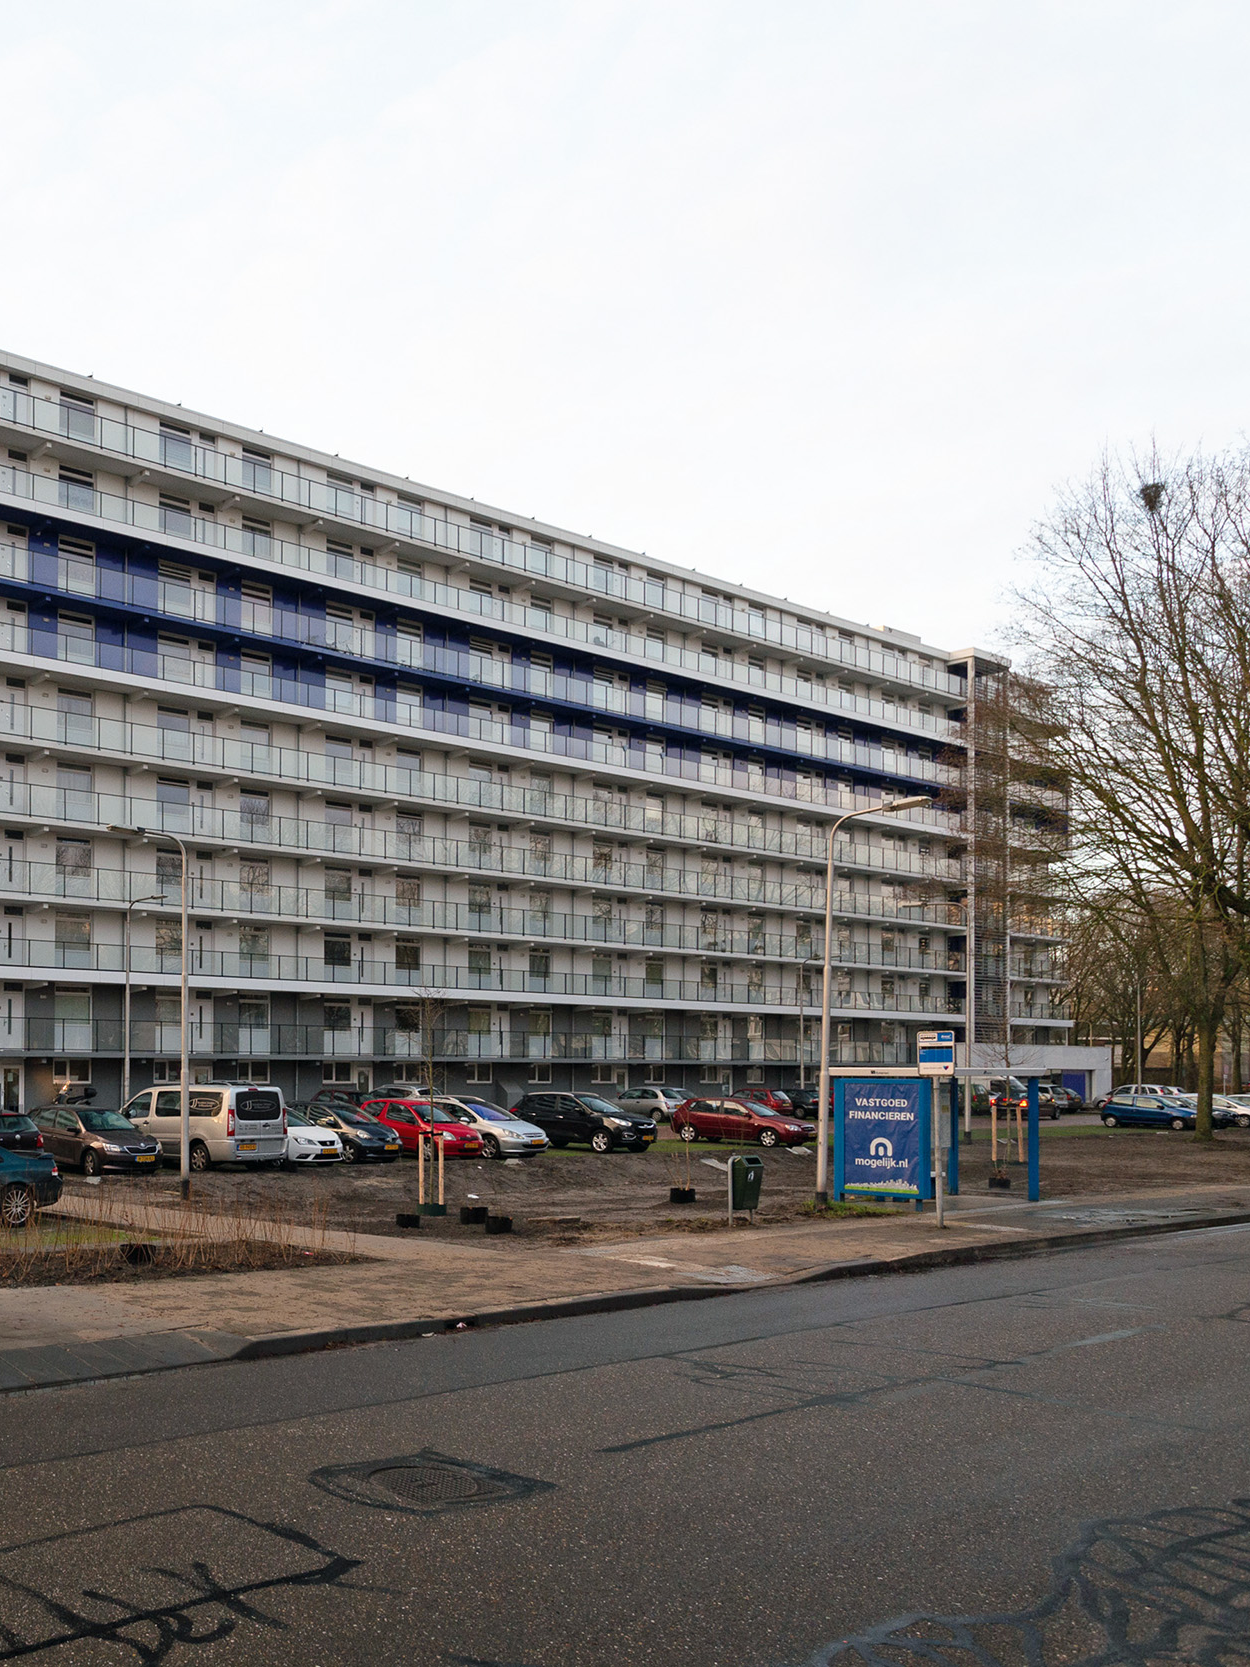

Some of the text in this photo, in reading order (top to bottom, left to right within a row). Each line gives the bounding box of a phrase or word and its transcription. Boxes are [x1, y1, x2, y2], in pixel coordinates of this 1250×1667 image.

[855, 1098, 908, 1108] VASTGOED
[849, 1110, 914, 1121] FINANCIEREN
[855, 1157, 908, 1169] mogelijk.nl
